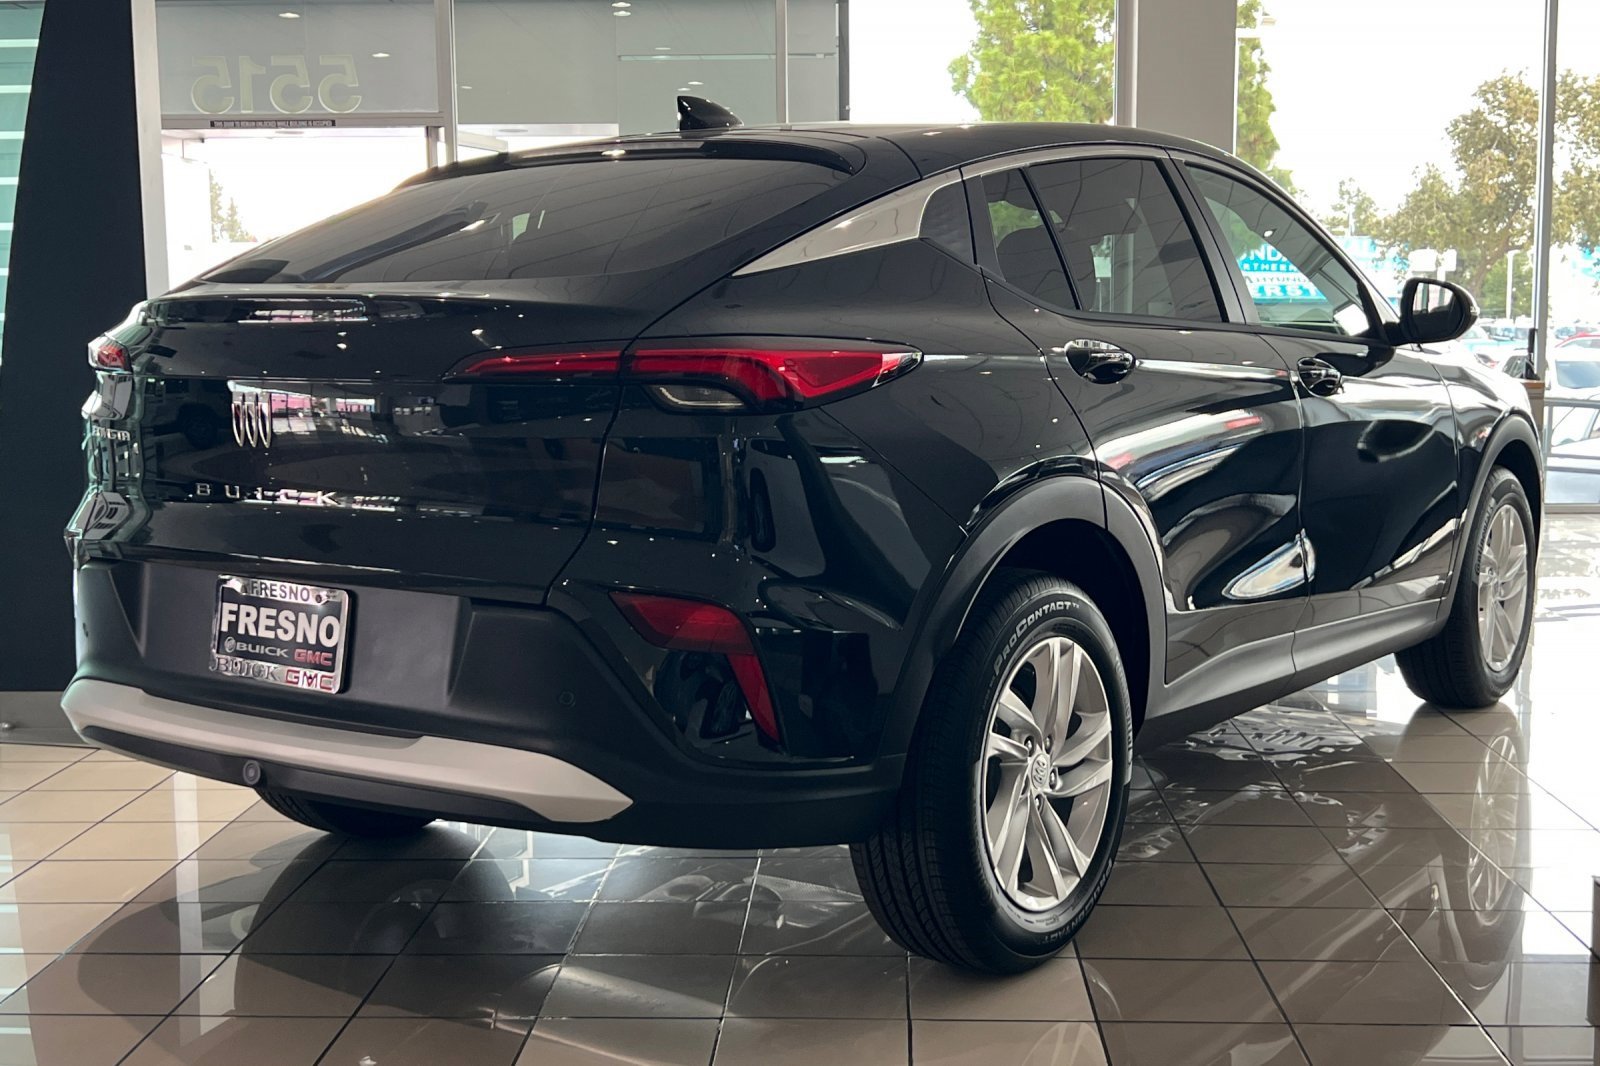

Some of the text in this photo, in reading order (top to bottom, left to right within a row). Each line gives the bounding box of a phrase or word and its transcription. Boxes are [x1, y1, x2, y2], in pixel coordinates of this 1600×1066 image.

[195, 482, 340, 506] BUICK
[251, 579, 310, 602] FRESNO
[220, 601, 340, 648] FRESNO
[236, 641, 333, 666] BUICK GMC
[211, 657, 334, 691] BUICK GMC
